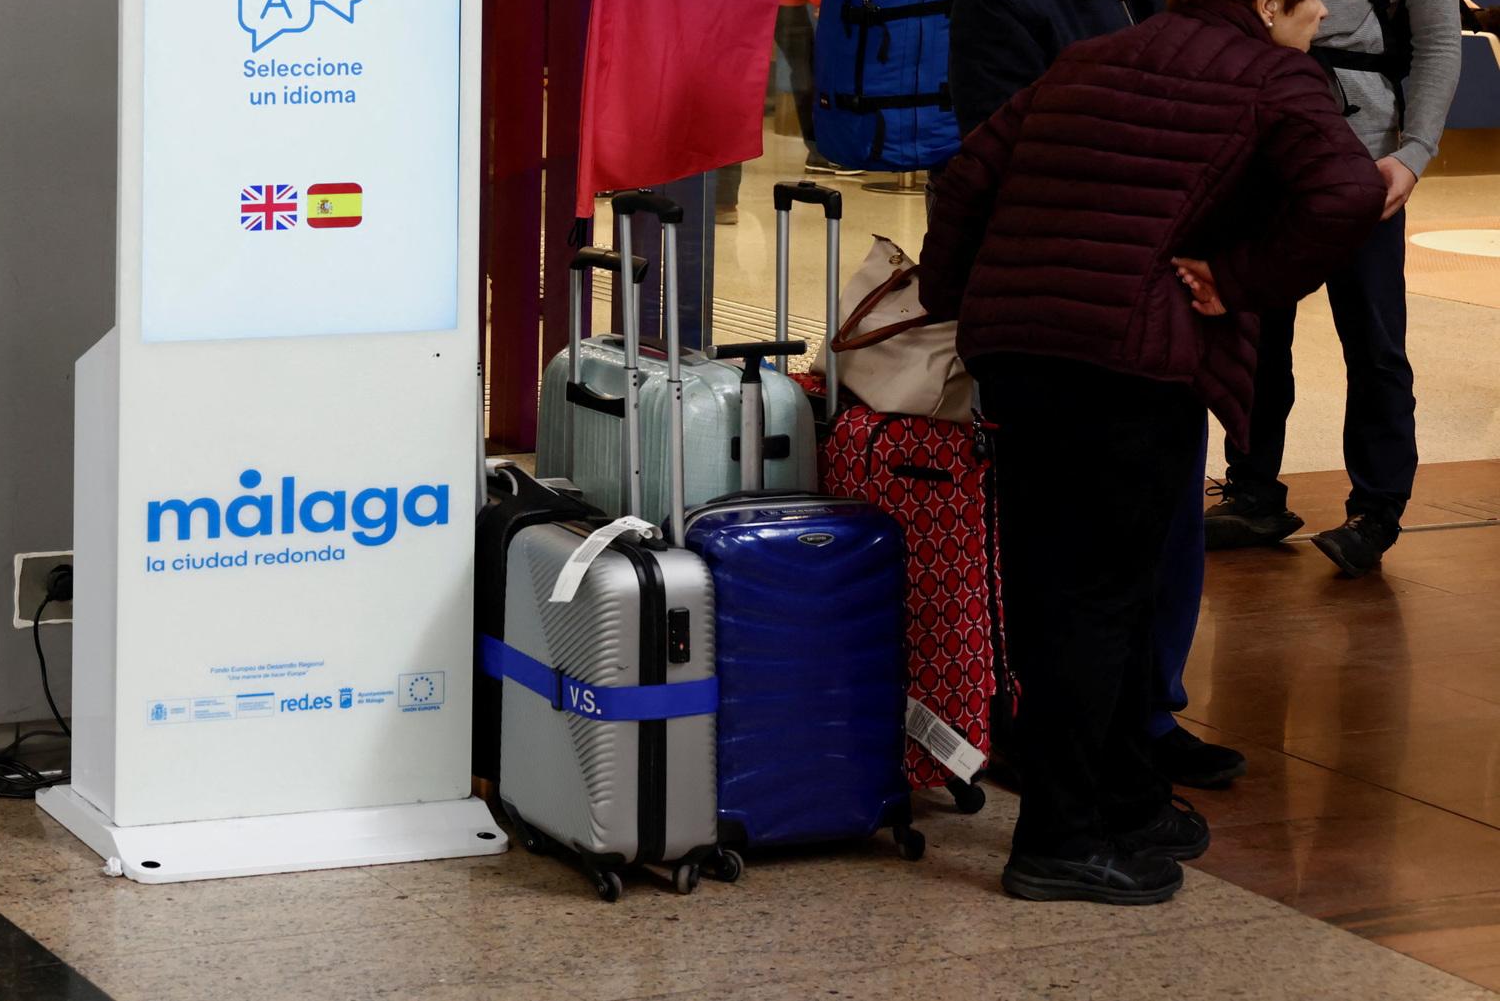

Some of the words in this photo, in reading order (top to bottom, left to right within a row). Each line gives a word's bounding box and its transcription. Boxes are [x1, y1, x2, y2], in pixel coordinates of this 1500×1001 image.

[243, 56, 363, 78] Seleccione
[249, 91, 277, 106] un
[283, 84, 356, 105] idioma
[147, 556, 166, 573] la
[172, 550, 248, 571] ciudad
[255, 544, 346, 566] redonda
[280, 693, 333, 713] red.es
[570, 685, 602, 715] V.S.
